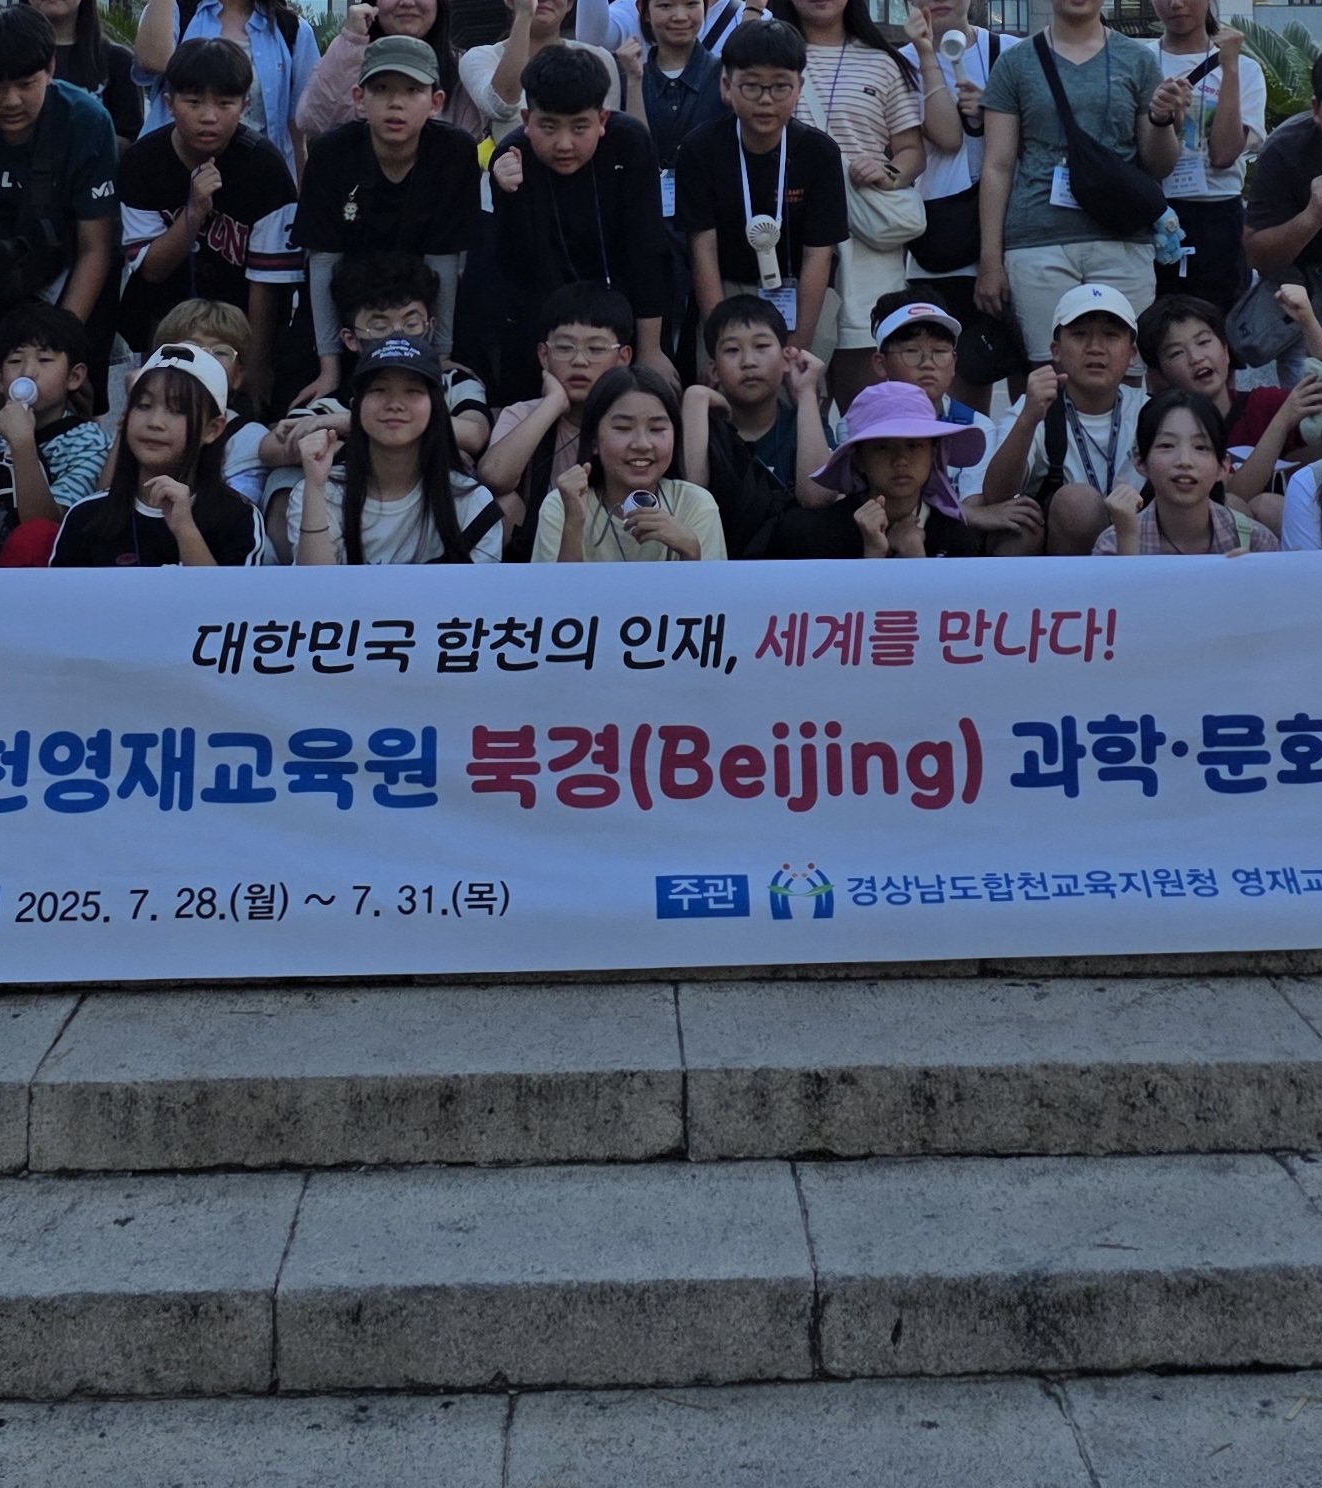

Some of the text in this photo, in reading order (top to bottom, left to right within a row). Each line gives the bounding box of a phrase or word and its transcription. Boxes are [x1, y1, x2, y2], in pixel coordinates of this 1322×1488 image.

[193, 607, 1117, 675] 대한민국 합천의 인재, 세계를 만나다!
[465, 717, 983, 813] 북경(Beijing)
[14, 890, 111, 924] 2025.
[129, 889, 158, 922] 7.
[174, 881, 289, 923] 28.(월)
[352, 885, 381, 918] 7.
[396, 880, 510, 918] 31.(목)
[668, 877, 738, 911] 주관
[847, 866, 1220, 907] 경상남도합천교육지원청
